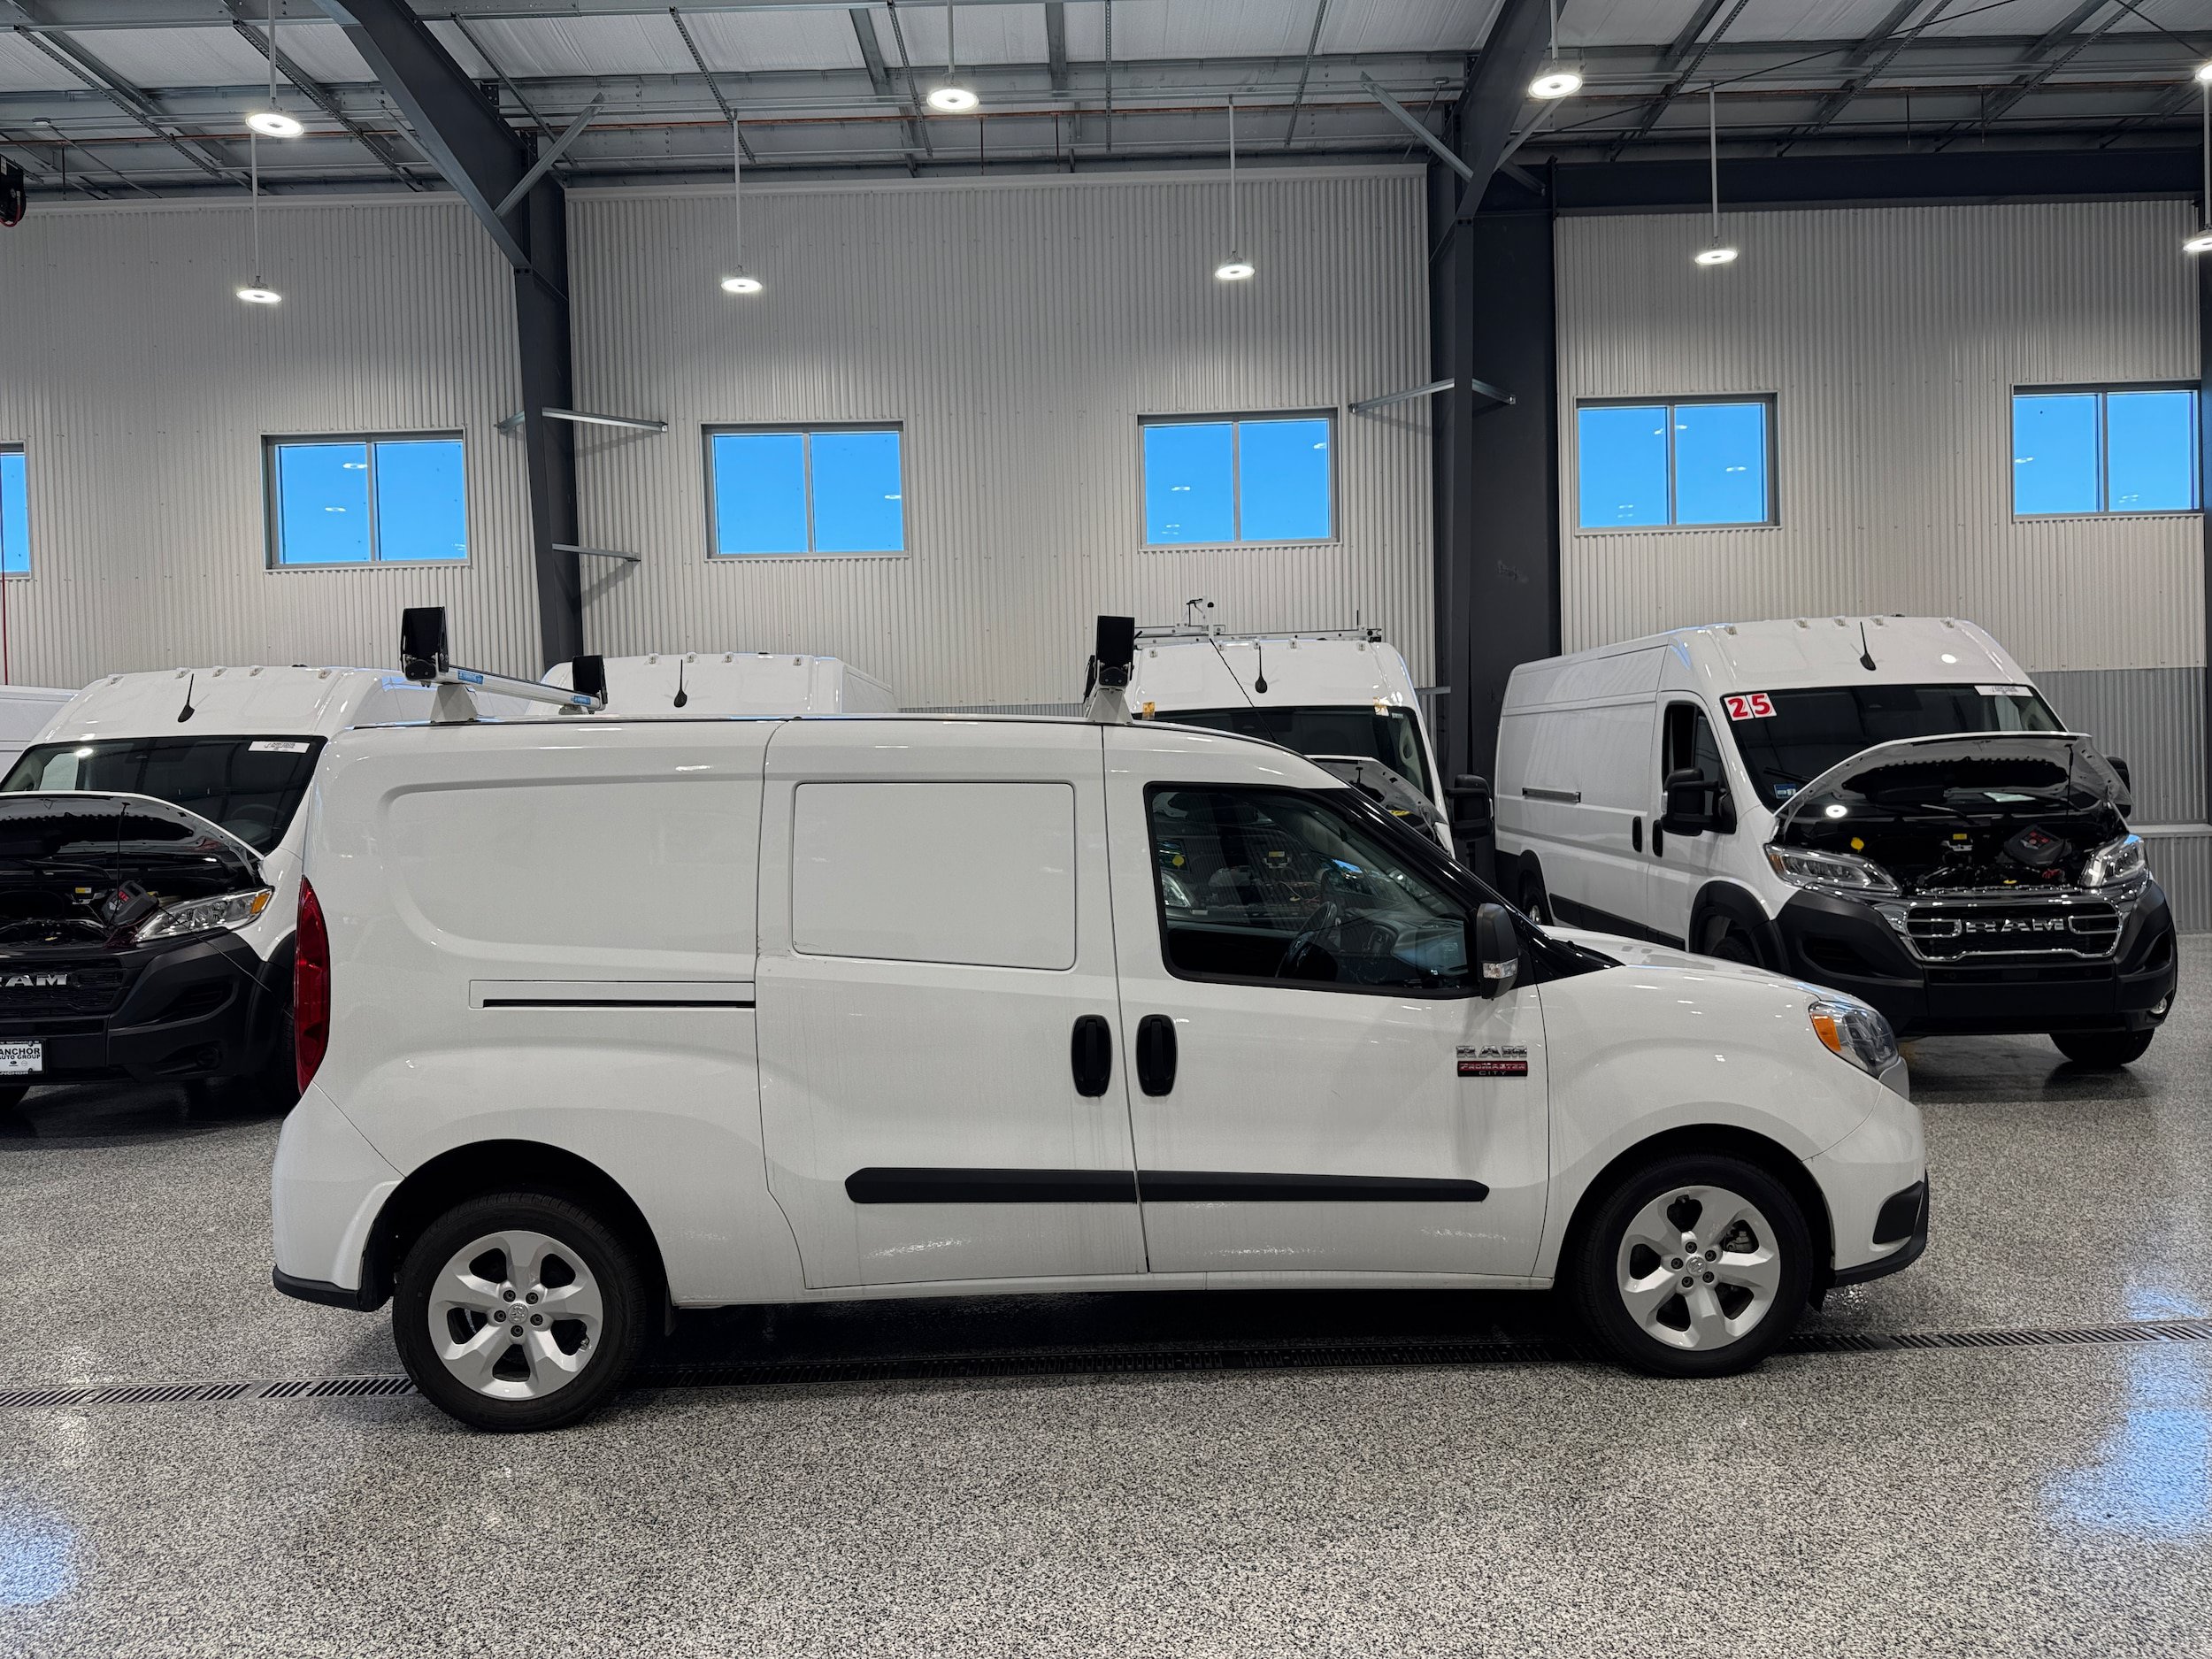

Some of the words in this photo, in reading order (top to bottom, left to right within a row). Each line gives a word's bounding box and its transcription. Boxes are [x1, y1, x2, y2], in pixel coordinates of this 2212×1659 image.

[1727, 694, 1771, 718] 25
[1964, 918, 2065, 933] RAM
[0, 973, 68, 987] AM
[1455, 1045, 1528, 1059] RAM
